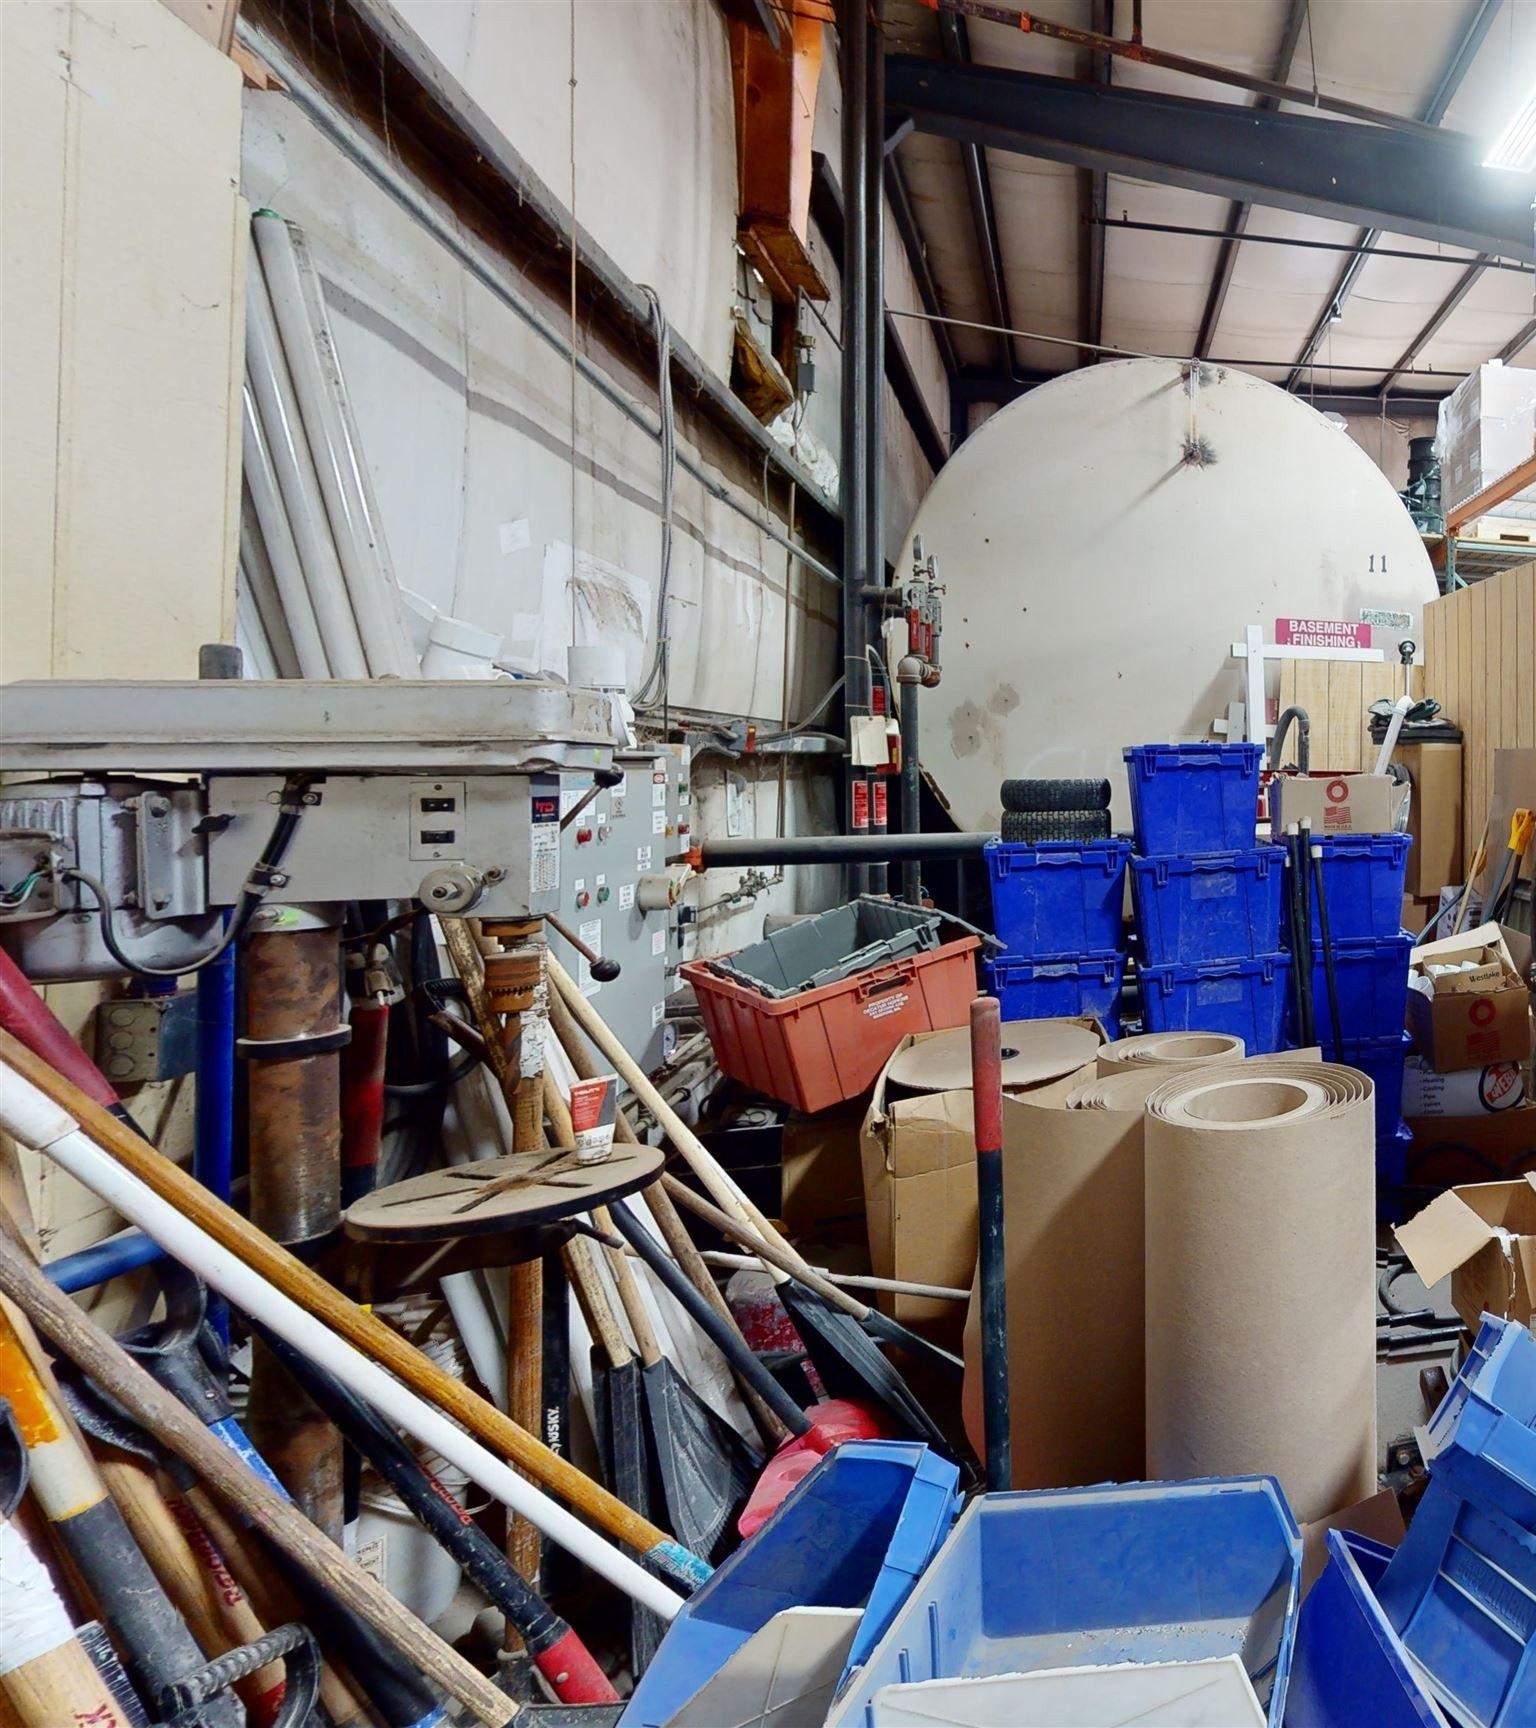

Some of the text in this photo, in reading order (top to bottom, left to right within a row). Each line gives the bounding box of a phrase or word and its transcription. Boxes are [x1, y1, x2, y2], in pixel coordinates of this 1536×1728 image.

[1369, 554, 1387, 573] 11
[1289, 620, 1359, 635] BASEMENT
[1292, 633, 1355, 647] FINISHING
[1468, 971, 1500, 983] Westlake
